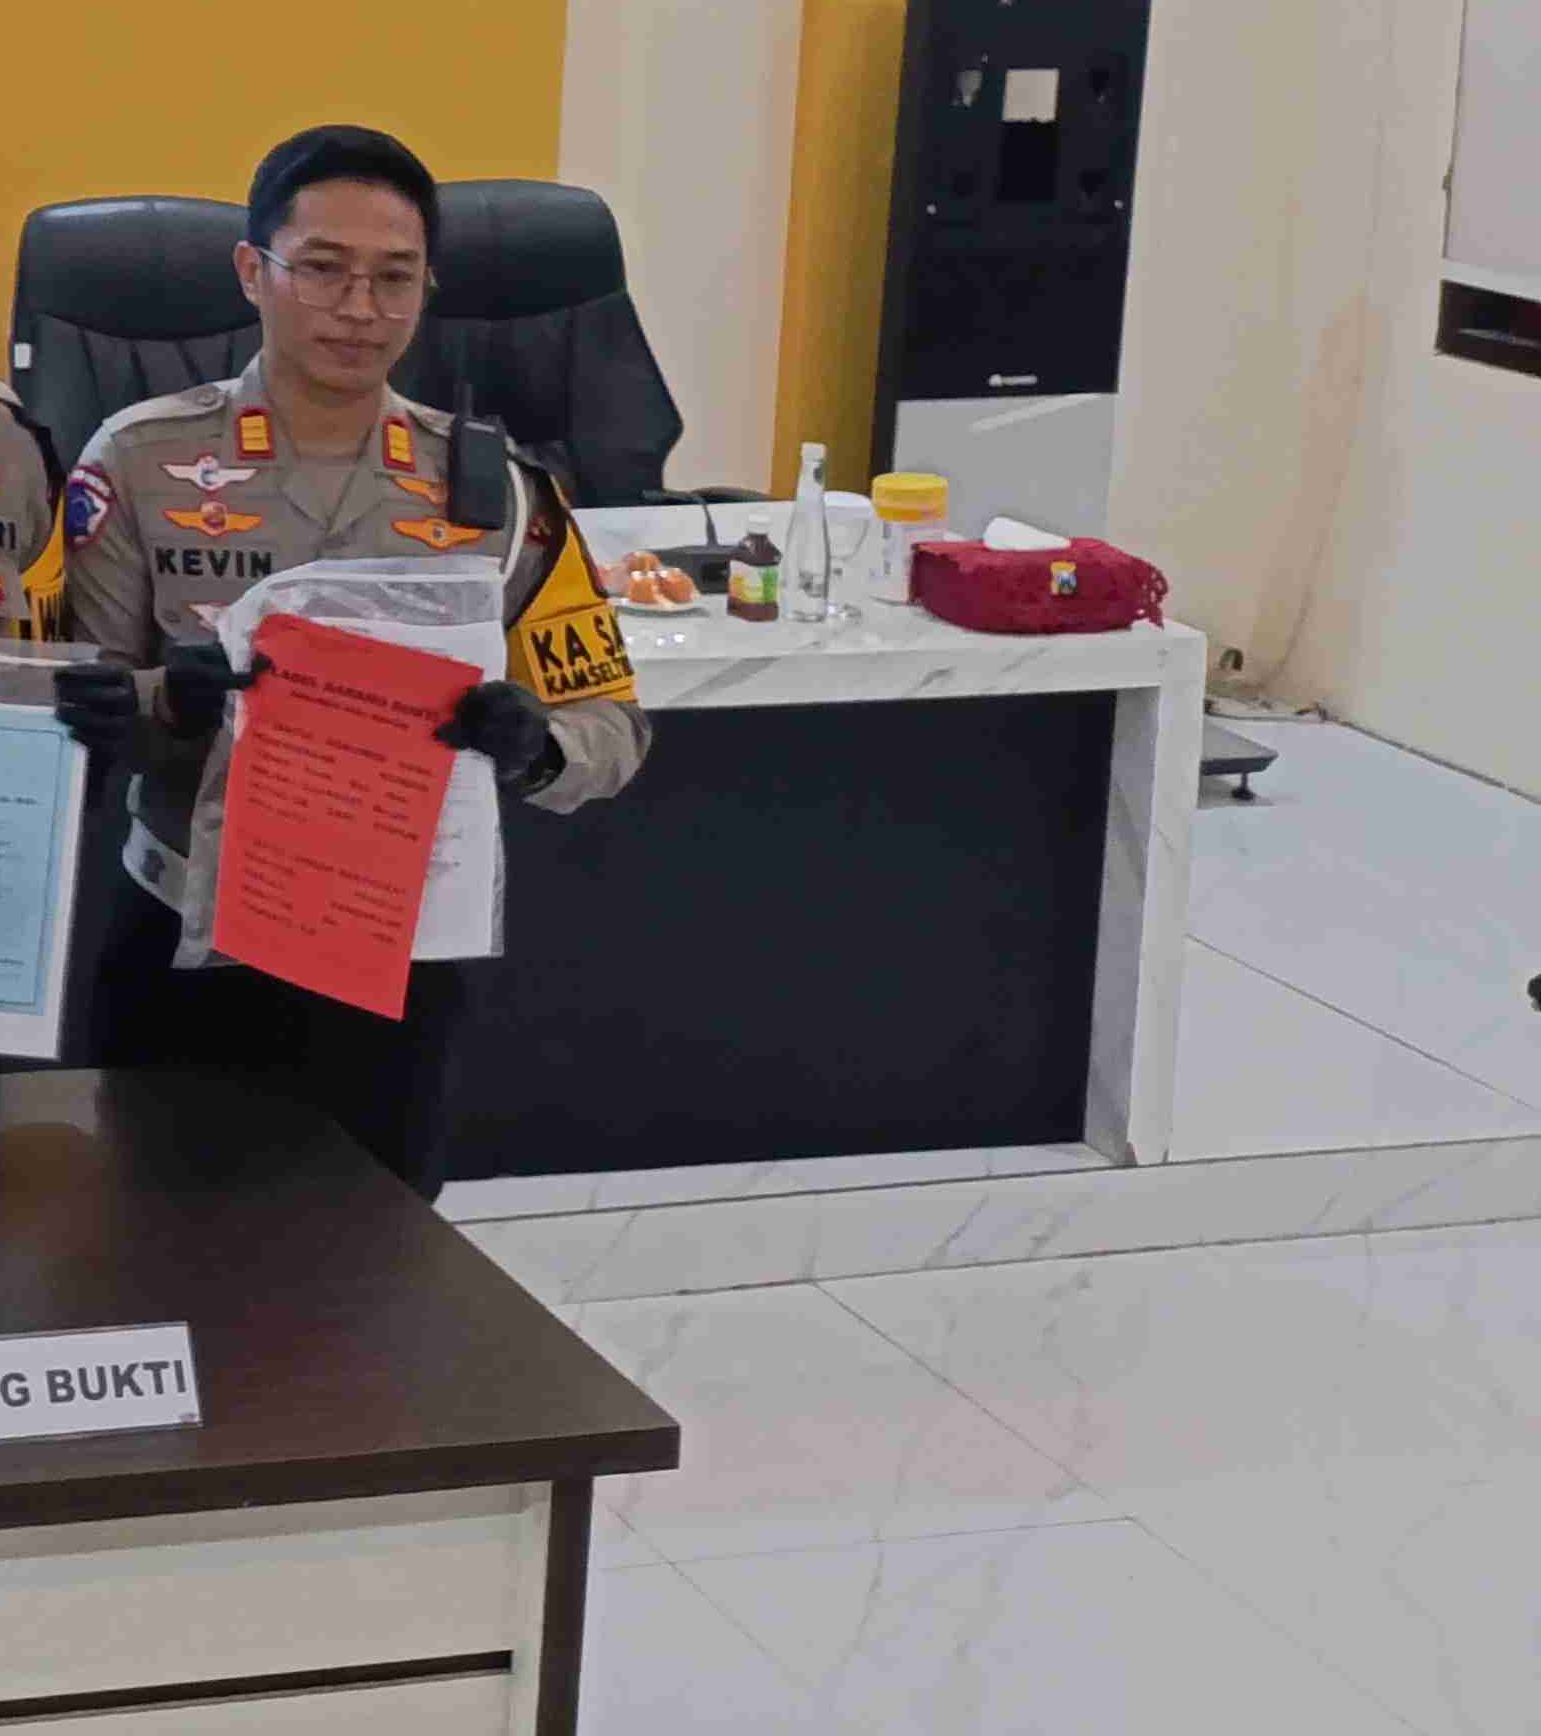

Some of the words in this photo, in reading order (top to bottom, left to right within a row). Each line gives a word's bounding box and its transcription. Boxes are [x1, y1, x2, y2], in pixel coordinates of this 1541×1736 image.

[154, 547, 273, 579] KEVIN
[530, 623, 592, 674] KA
[45, 1359, 187, 1406] BUKTI
